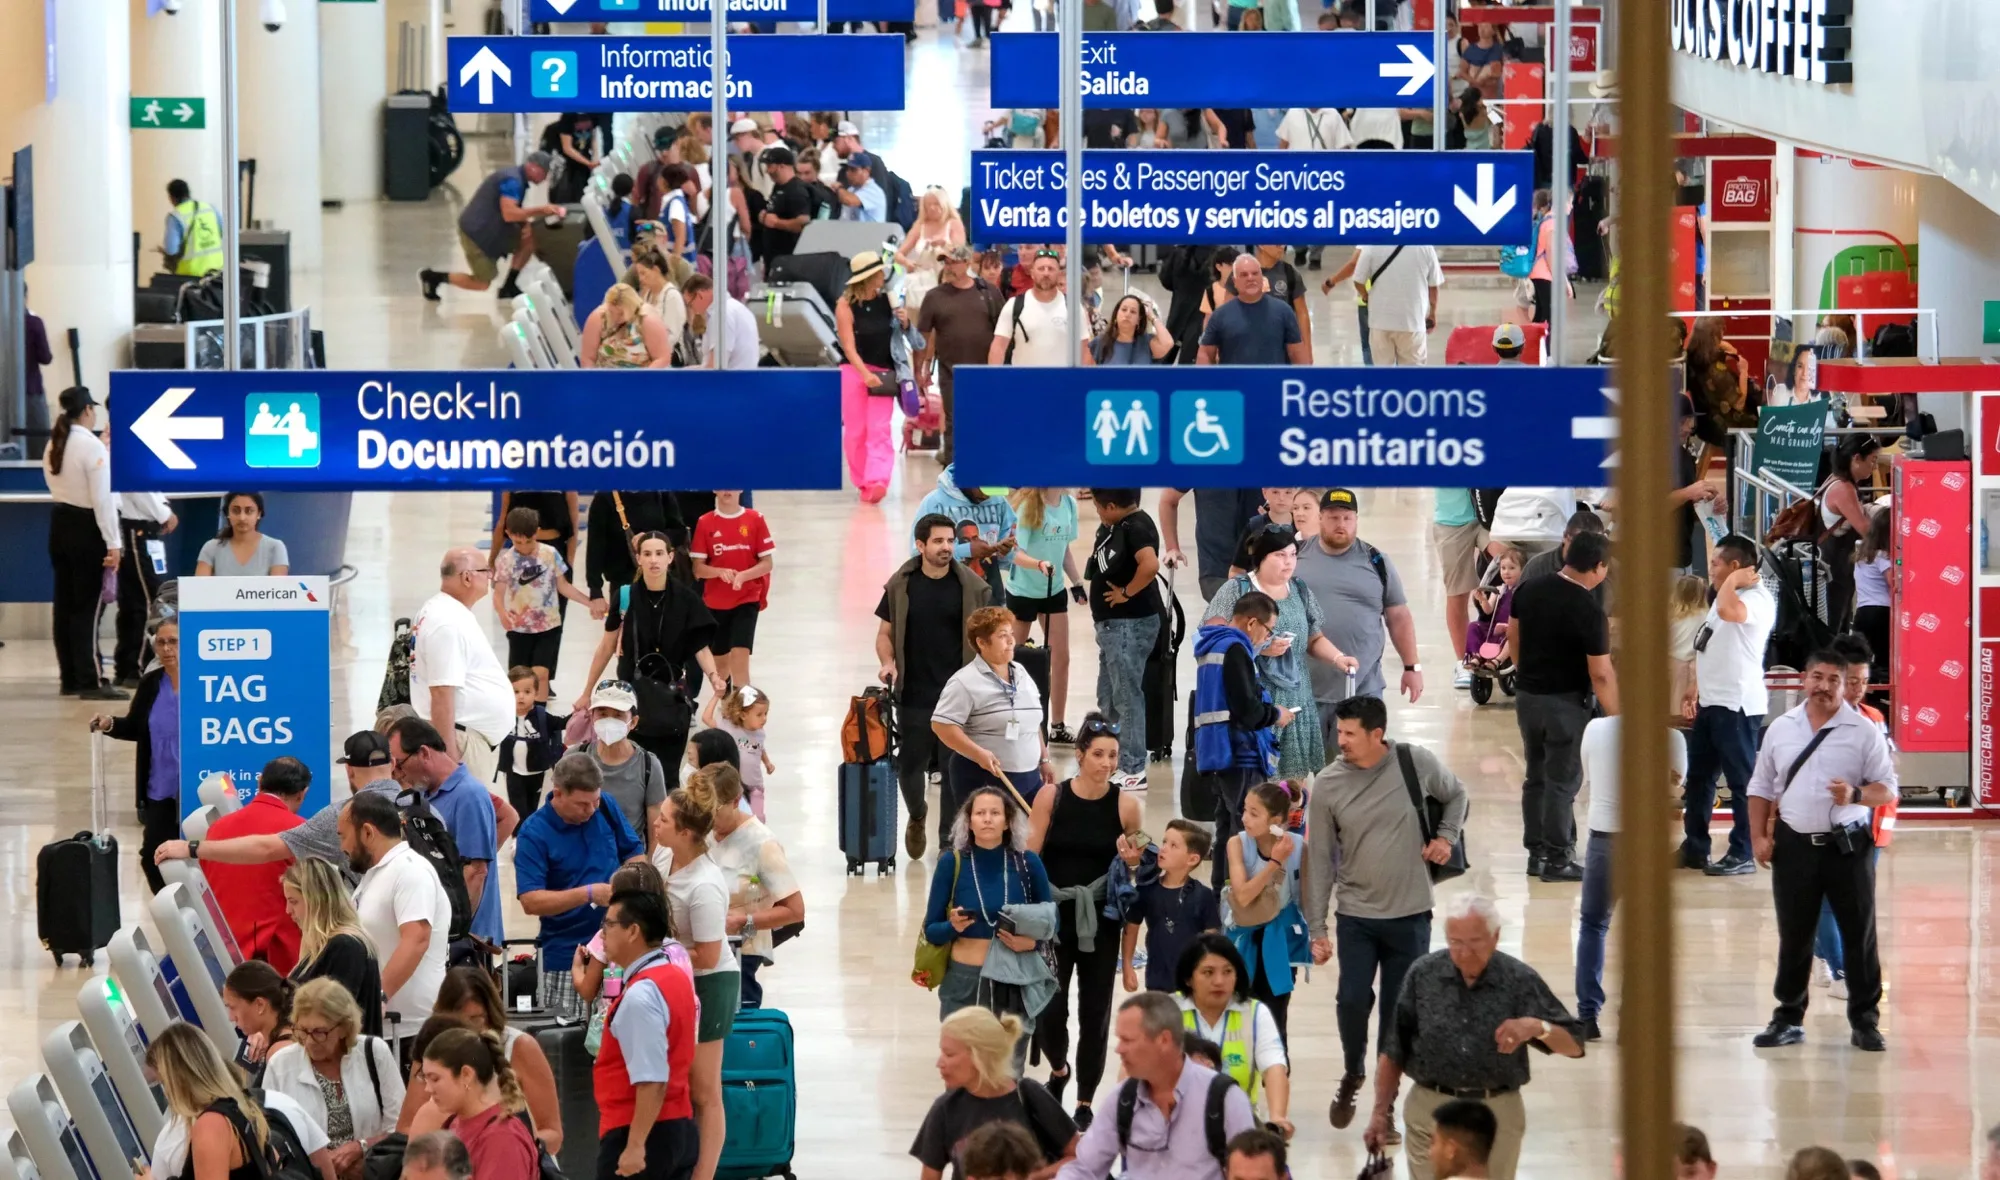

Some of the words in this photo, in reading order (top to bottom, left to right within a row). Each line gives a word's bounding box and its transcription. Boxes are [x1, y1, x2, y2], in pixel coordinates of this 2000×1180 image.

[1080, 40, 1117, 65] Exit
[1671, 0, 1723, 62] UCKS
[1727, 0, 1828, 84] COFFEE
[601, 74, 753, 98] Informacón
[1080, 70, 1149, 95] Salida
[980, 162, 1045, 190] Ticket
[1050, 162, 1107, 190] Ses
[1113, 162, 1132, 190] &
[1138, 162, 1249, 197] Passenger
[1255, 163, 1345, 191] Services
[1725, 190, 1756, 203] BAG
[980, 199, 1051, 228] Venta
[1092, 200, 1180, 228] boletos
[1186, 207, 1200, 235] y
[1205, 200, 1307, 229] servicios
[1313, 200, 1334, 229] al
[1339, 200, 1440, 235] pasajero
[357, 380, 521, 420] Check-In
[1281, 379, 1487, 418] Restrooms
[357, 429, 676, 470] Documentación
[1279, 427, 1486, 467] Sanitarios
[1788, 438, 1812, 448] GRANDE
[235, 588, 298, 600] American
[207, 638, 246, 652] STEP
[252, 638, 259, 651] 1
[199, 674, 267, 703] TAG
[201, 716, 293, 745] BAGS
[240, 769, 252, 780] in
